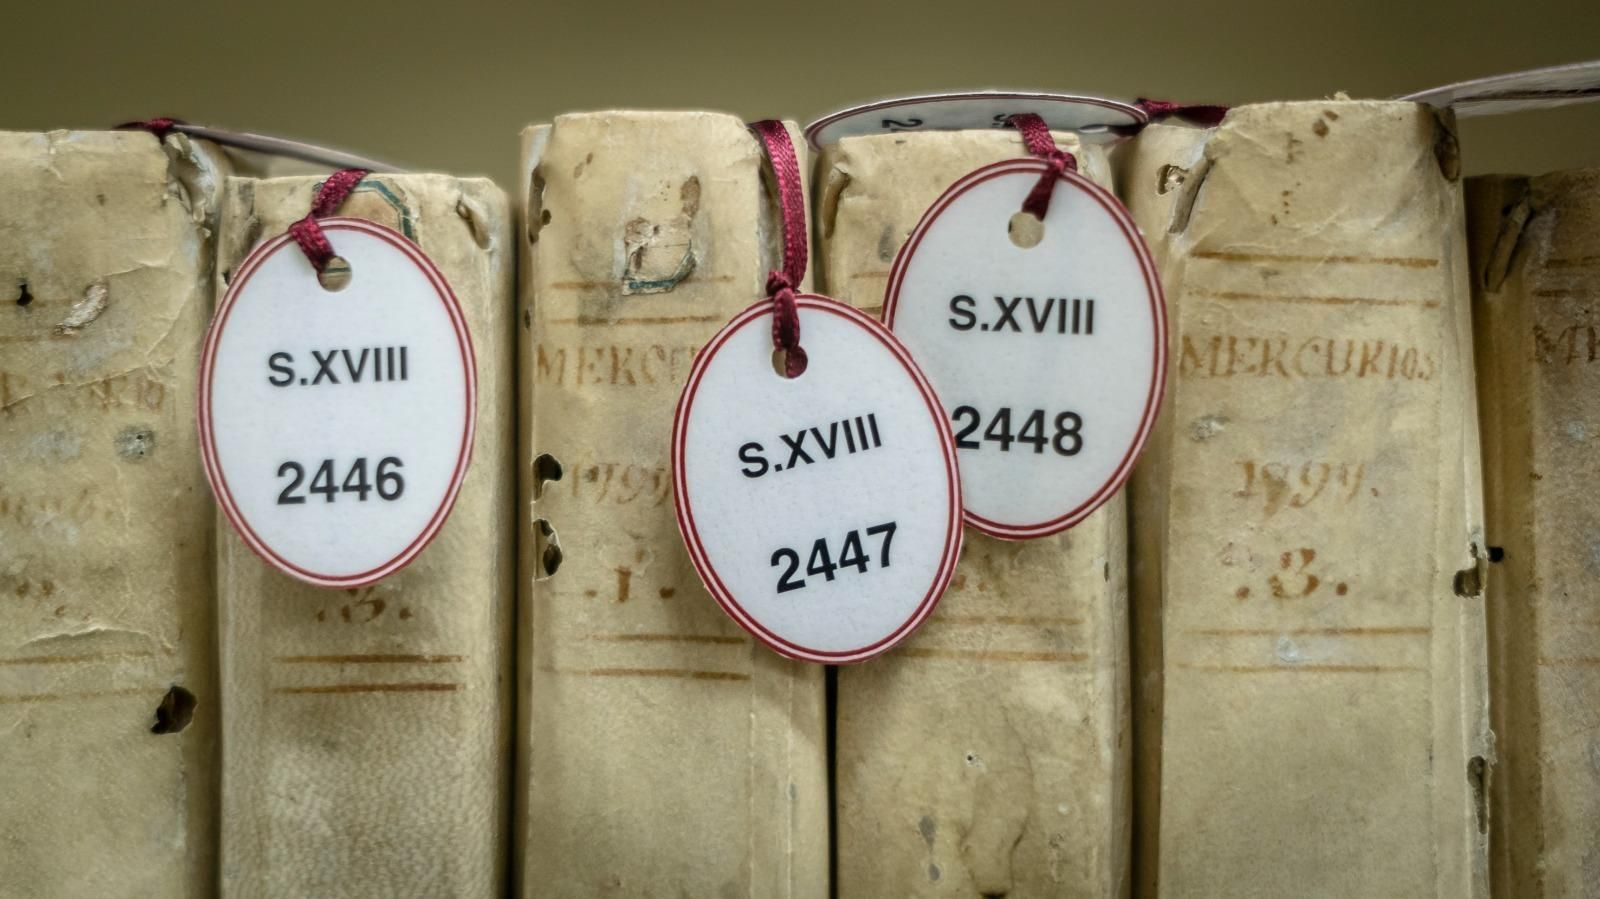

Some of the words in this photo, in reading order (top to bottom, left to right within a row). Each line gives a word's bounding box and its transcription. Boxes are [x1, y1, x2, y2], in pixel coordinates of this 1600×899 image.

[948, 294, 1095, 335] S.XVIII
[268, 346, 407, 387] S.XVIII
[738, 413, 882, 479] S.XVIII
[952, 405, 1084, 457] 2448
[277, 456, 404, 505] 2446
[770, 521, 897, 594] 2447
